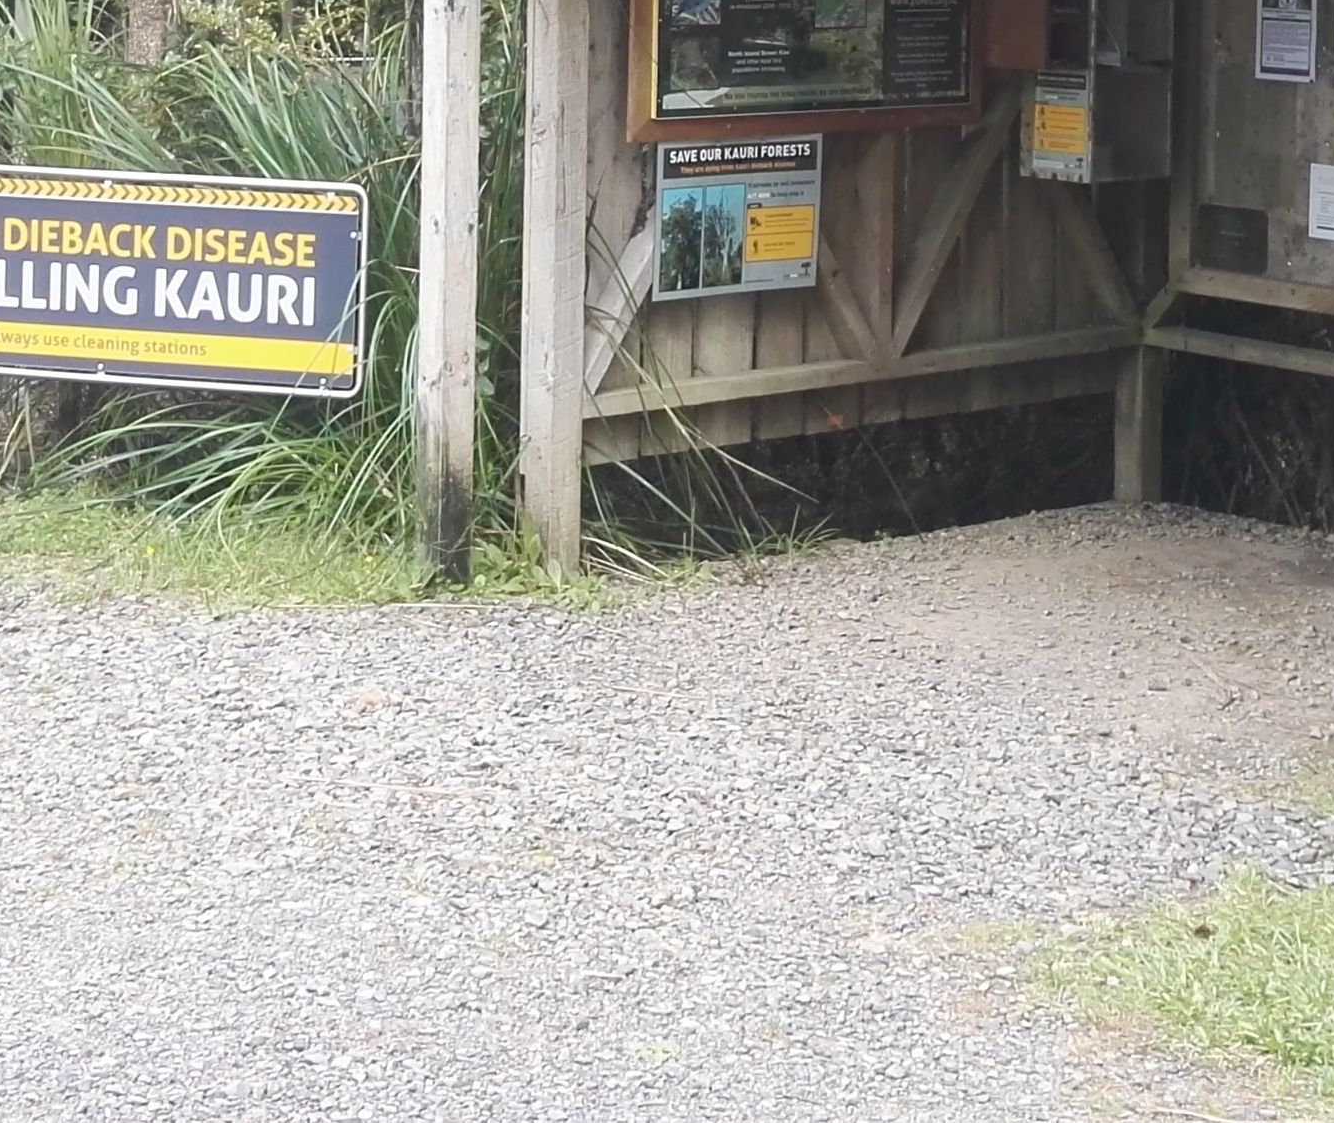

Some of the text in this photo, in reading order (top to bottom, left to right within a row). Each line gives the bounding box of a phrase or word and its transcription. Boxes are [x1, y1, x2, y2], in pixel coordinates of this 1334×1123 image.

[669, 143, 811, 165] SAVE OUR KAURI FORESTS
[3, 218, 157, 261] DIEBACK
[166, 227, 317, 269] DISEASE
[153, 268, 317, 328] KAURI
[43, 333, 69, 348] use
[73, 333, 140, 356] cleaning
[143, 339, 208, 357] stations
